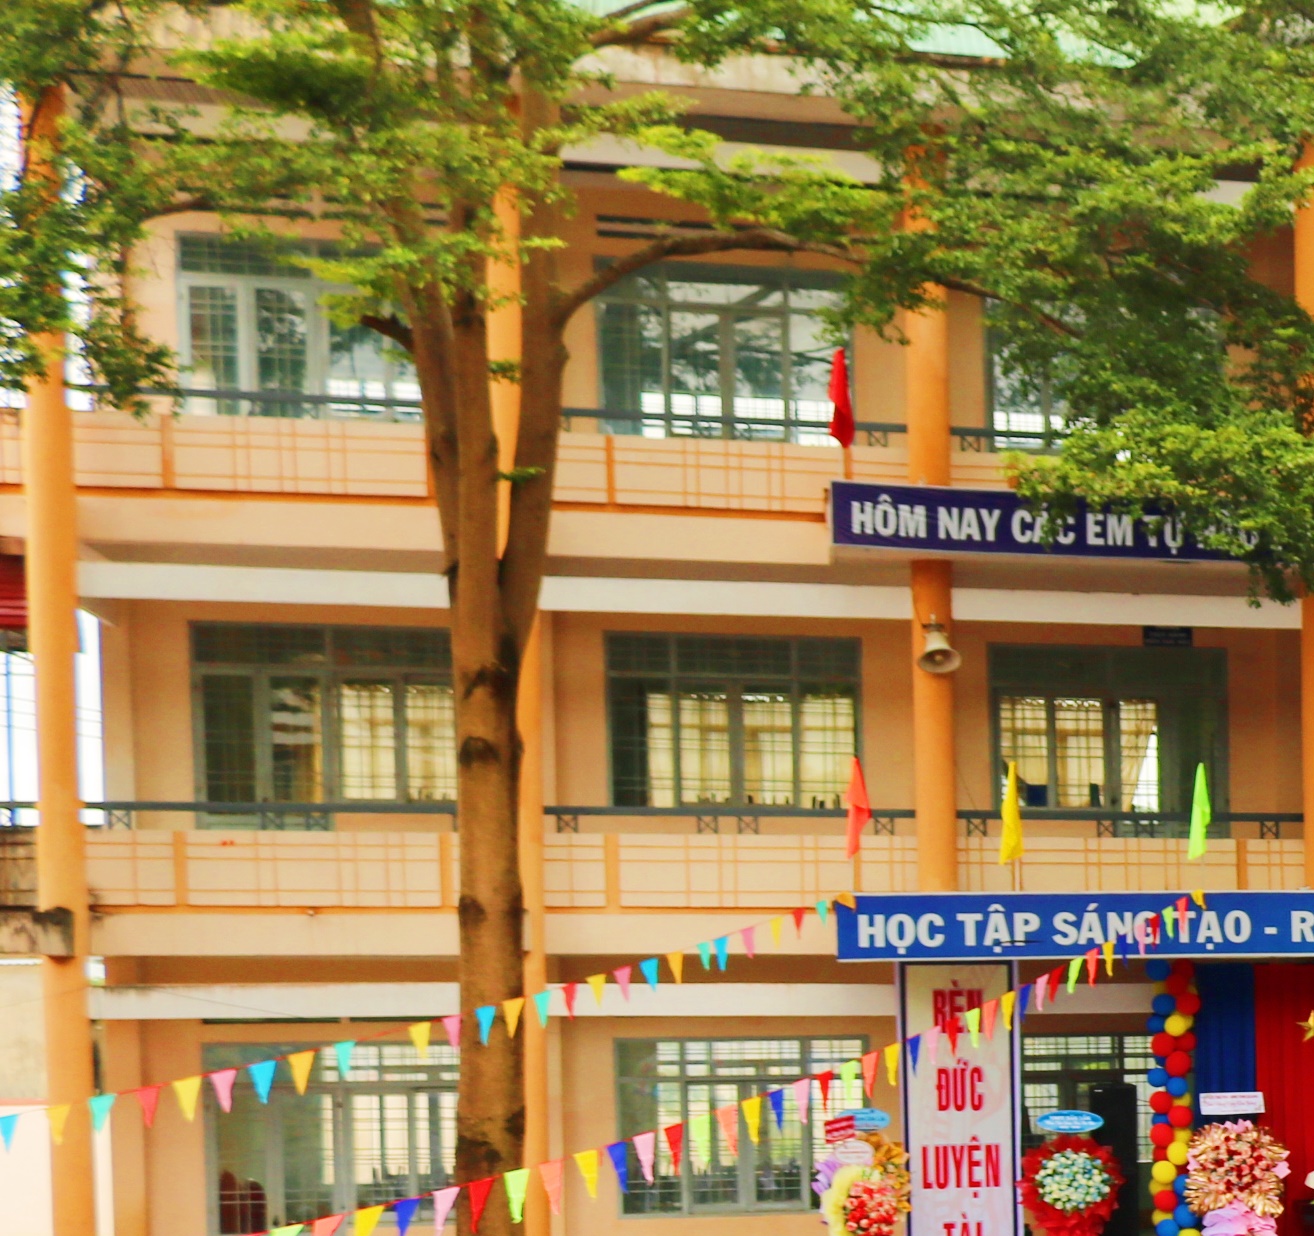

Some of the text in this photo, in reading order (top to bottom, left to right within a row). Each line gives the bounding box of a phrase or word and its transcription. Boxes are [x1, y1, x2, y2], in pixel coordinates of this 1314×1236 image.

[851, 495, 927, 538] HÔM
[938, 507, 1001, 542] NAY
[1086, 512, 1133, 546] EM
[857, 912, 945, 953] HỌC
[956, 906, 1041, 953] TẬP
[1052, 903, 1160, 946] SÁNG
[1172, 909, 1251, 950] TẠO
[932, 979, 983, 1033] RÈN
[936, 1060, 984, 1112] ĐỨC
[922, 1136, 1000, 1199] LUYỆN
